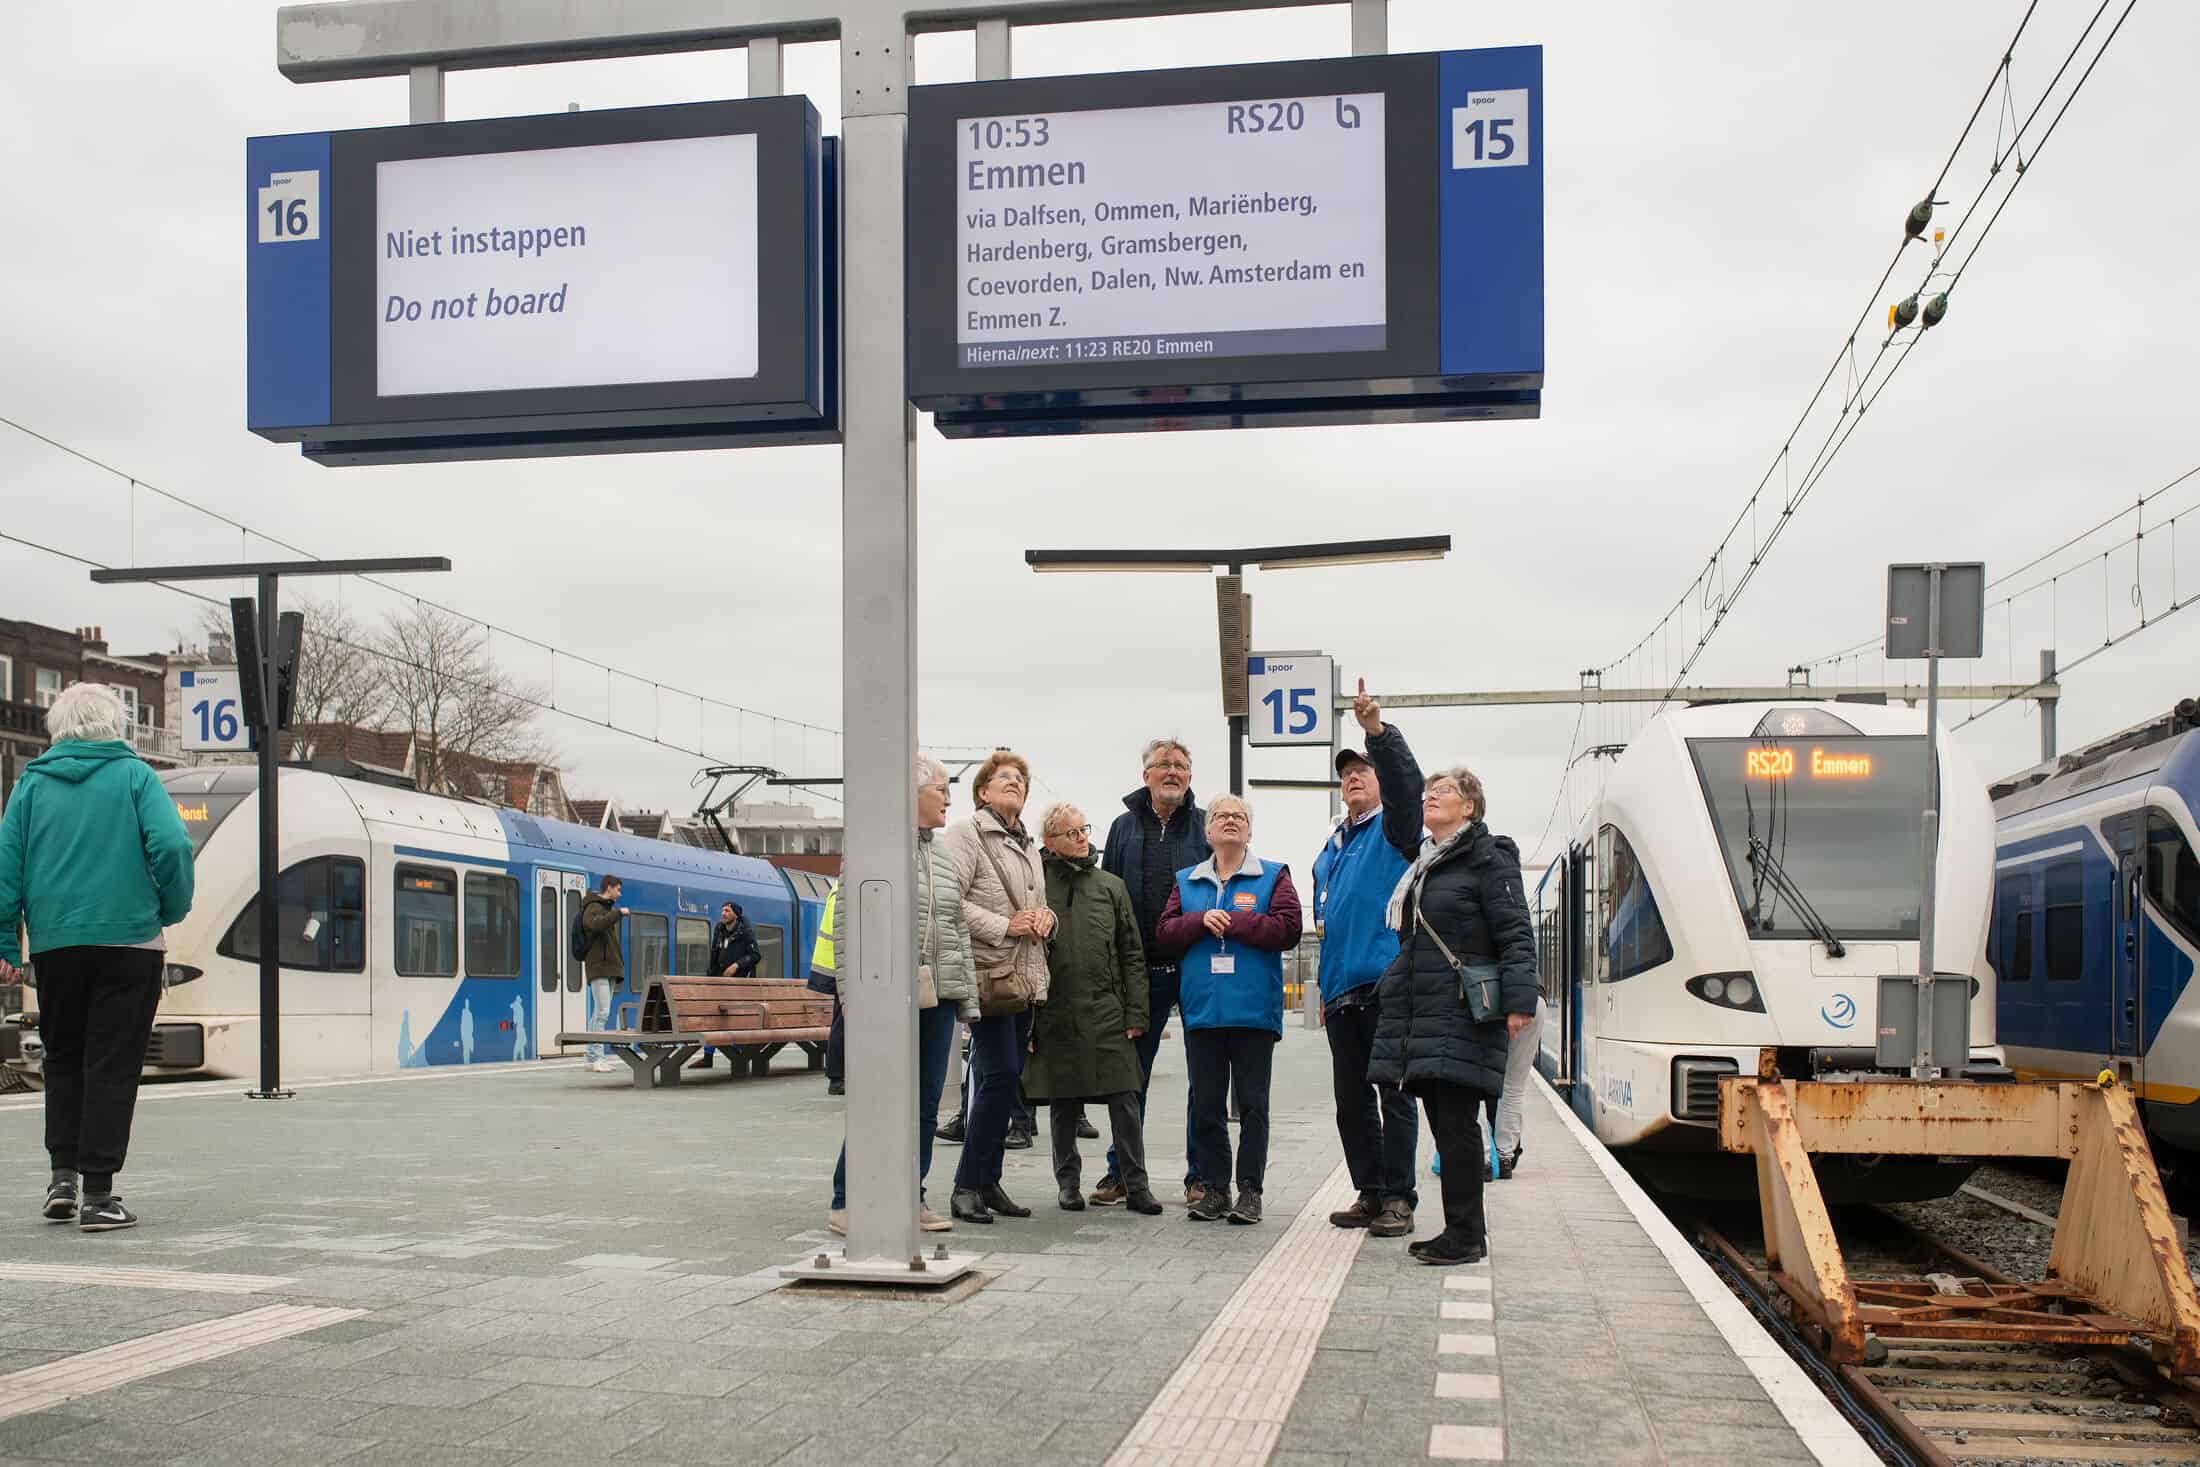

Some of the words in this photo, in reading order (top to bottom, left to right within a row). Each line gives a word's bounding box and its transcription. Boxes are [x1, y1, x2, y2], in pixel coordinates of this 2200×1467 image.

[1226, 100, 1305, 135] RS20
[1471, 97, 1496, 106] spoor
[967, 116, 1050, 151] 10:53
[1464, 118, 1515, 161] 15
[968, 159, 1085, 191] Emmen
[266, 198, 309, 237] 16
[966, 207, 996, 229] via
[1004, 203, 1086, 228] Dalfsen,
[1094, 201, 1180, 222] Ommen,
[1189, 191, 1318, 217] Mariënberg,
[386, 229, 443, 259] Niet
[451, 225, 586, 259] instappen
[967, 238, 1093, 264] Hardenberg,
[1101, 231, 1248, 256] Gramsbergen,
[966, 274, 1083, 297] Coevorden,
[1091, 268, 1157, 291] Dalen,
[1165, 266, 1204, 287] Nw.
[1208, 259, 1332, 285] Amsterdam
[1338, 262, 1365, 279] en
[384, 295, 422, 323] Do
[430, 292, 479, 321] not
[484, 282, 568, 317] board
[967, 311, 1042, 331] Emmen
[1048, 306, 1067, 327] Z.
[967, 345, 1060, 363] Hierna/next:
[1065, 342, 1107, 358] 11:23
[1112, 339, 1151, 356] RE20
[1156, 338, 1214, 354] Emmen
[1266, 664, 1294, 673] spoor
[192, 699, 238, 742] 16
[1262, 687, 1318, 735] 15
[1747, 750, 1793, 776] RS20
[1812, 750, 1870, 776] Emmen
